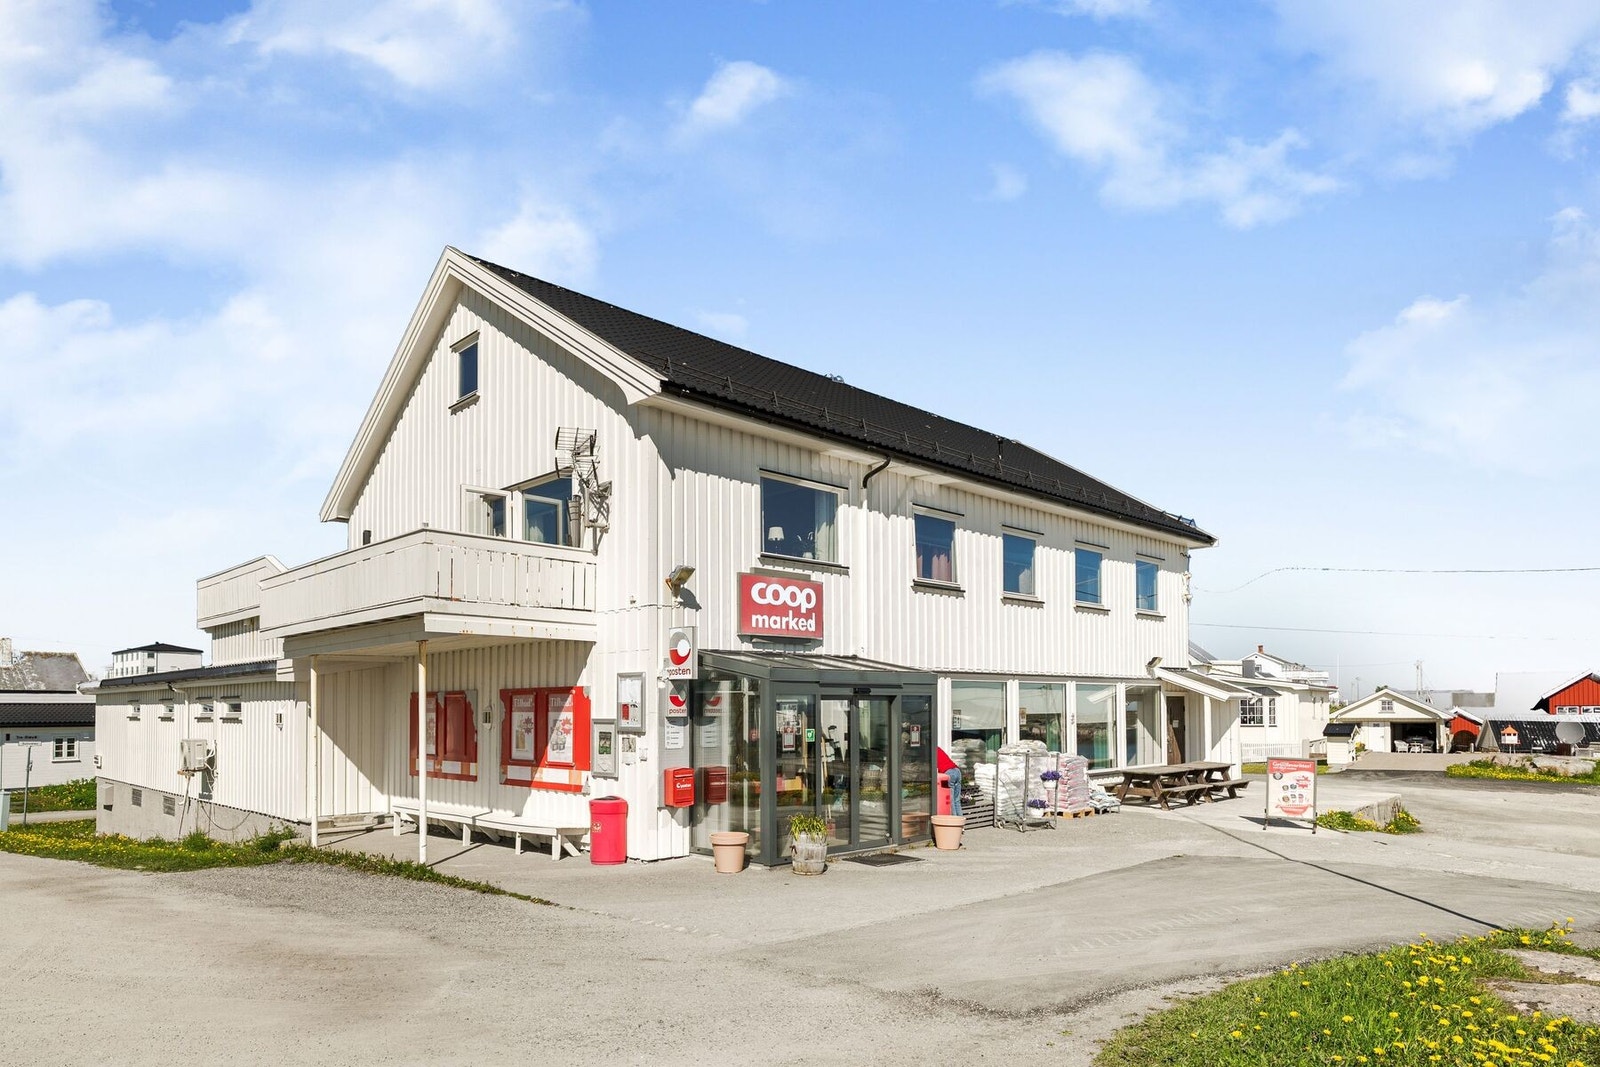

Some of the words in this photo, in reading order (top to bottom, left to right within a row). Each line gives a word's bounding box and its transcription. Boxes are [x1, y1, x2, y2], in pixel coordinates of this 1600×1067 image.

[751, 582, 816, 613] coop
[751, 610, 816, 631] marked
[667, 667, 691, 677] posten
